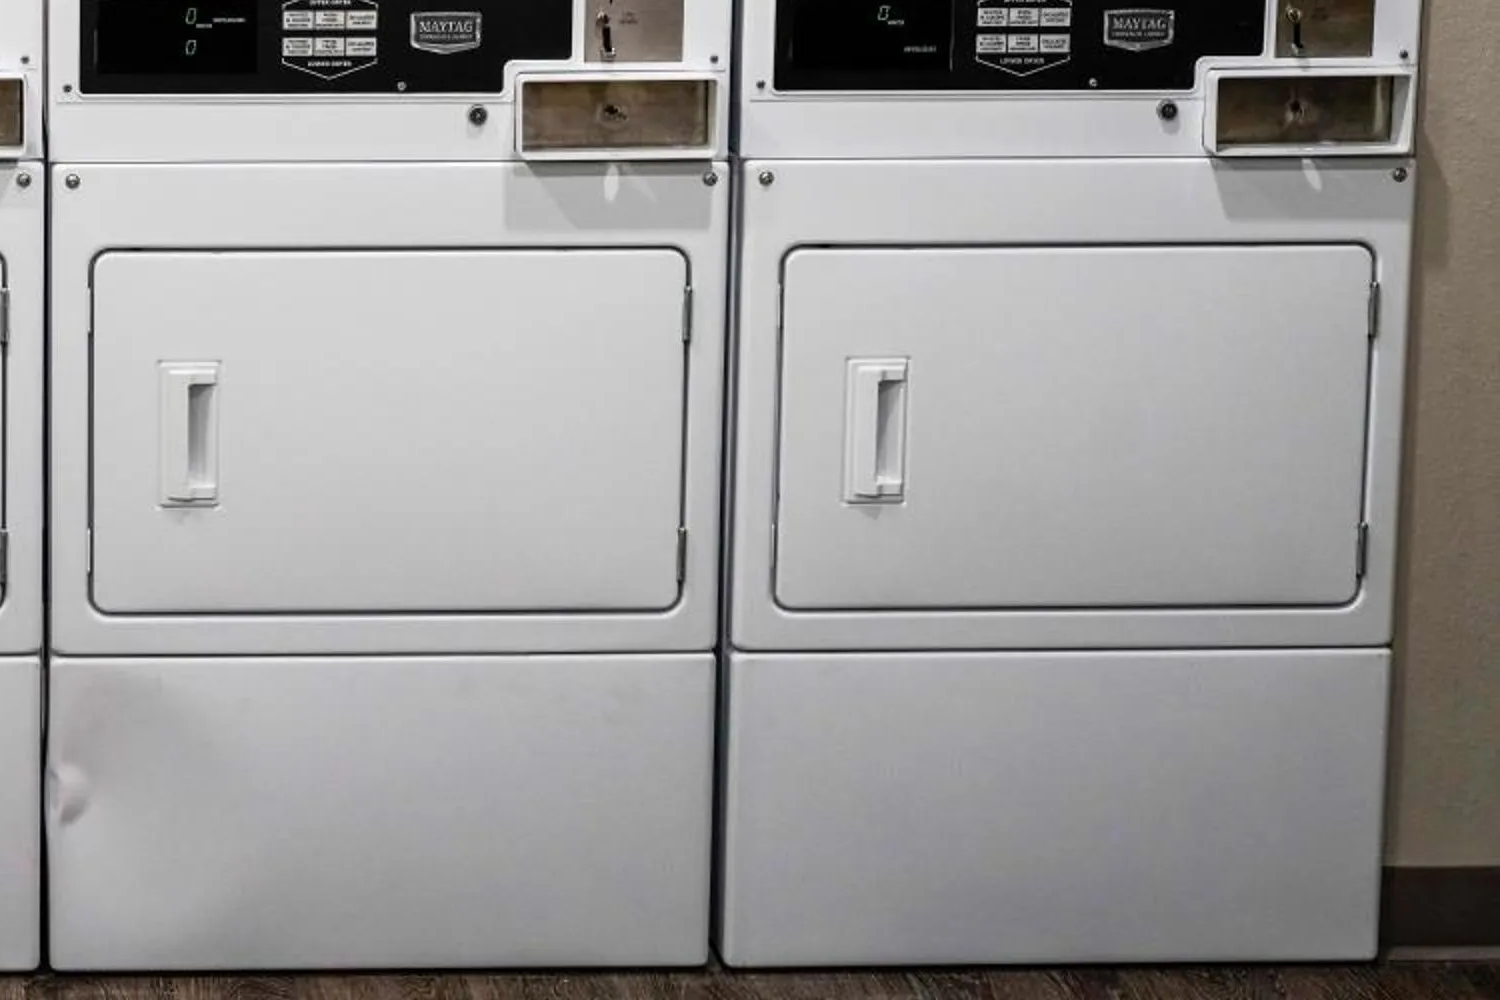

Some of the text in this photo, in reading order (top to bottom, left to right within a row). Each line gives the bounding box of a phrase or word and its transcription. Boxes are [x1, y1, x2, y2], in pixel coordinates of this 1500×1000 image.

[185, 7, 197, 25] 0
[1112, 17, 1167, 30] MAYTAG
[419, 21, 473, 33] MAYTAG
[185, 39, 197, 56] 0
